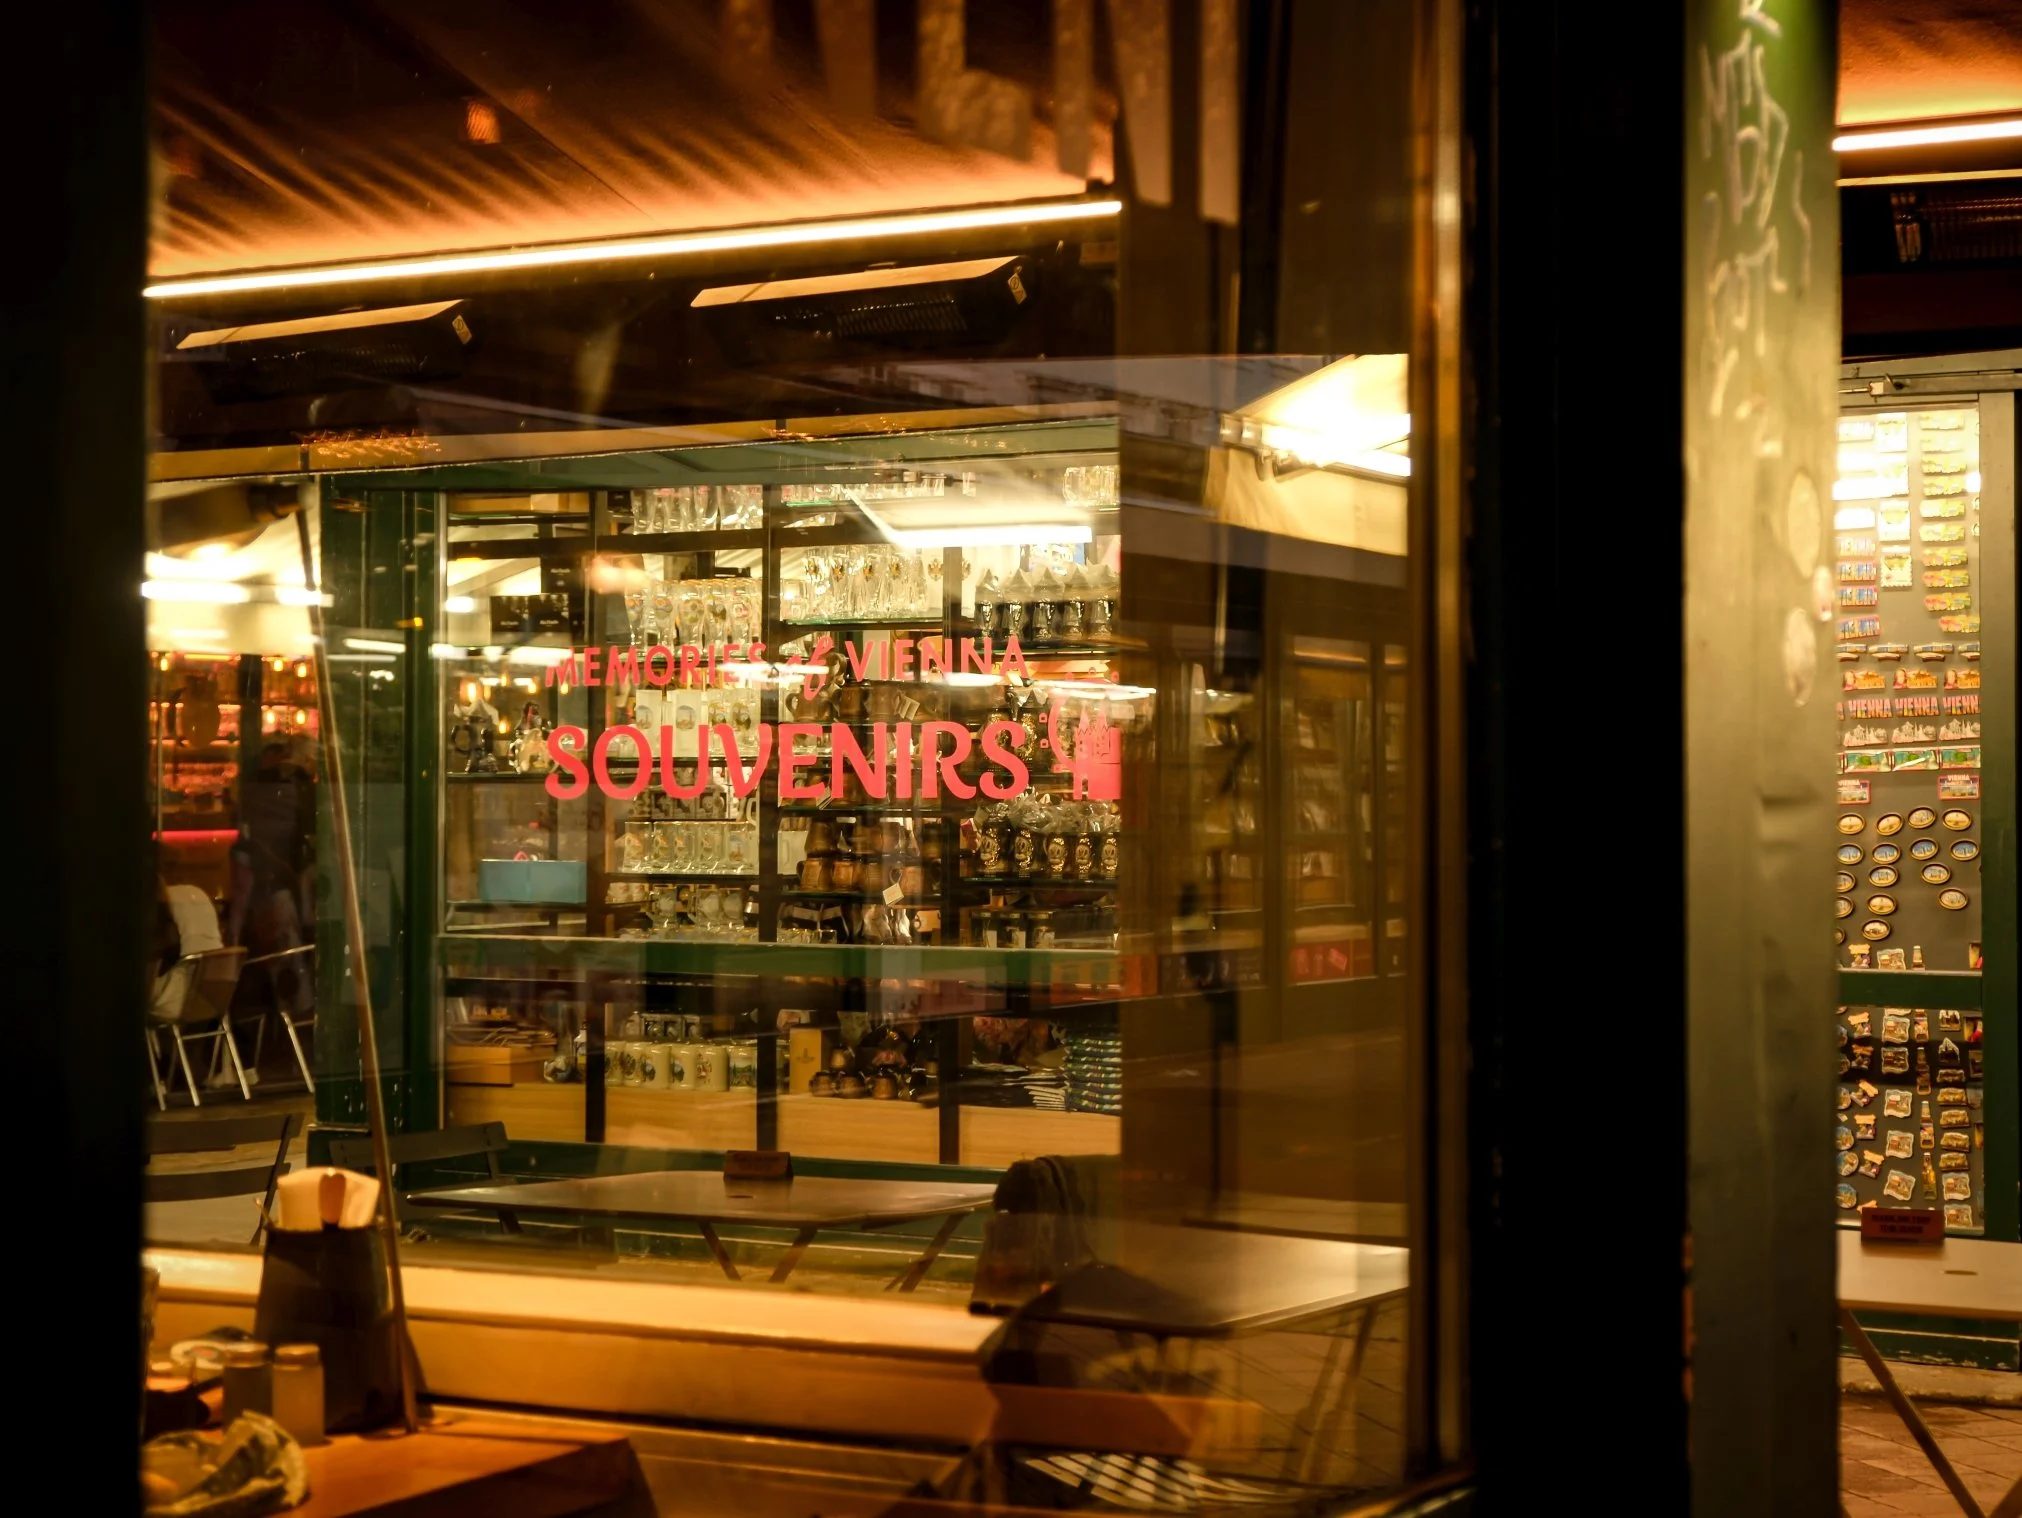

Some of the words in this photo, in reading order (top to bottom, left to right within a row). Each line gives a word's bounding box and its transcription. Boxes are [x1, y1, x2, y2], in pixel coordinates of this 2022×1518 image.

[545, 642, 767, 687] MEMORIES
[845, 635, 1029, 682] VIENNA
[1847, 699, 1893, 719] VIENNA
[1894, 697, 1940, 717] VIENNA
[1942, 695, 1980, 715] VIENN
[545, 721, 1029, 800] SOUVENIRS
